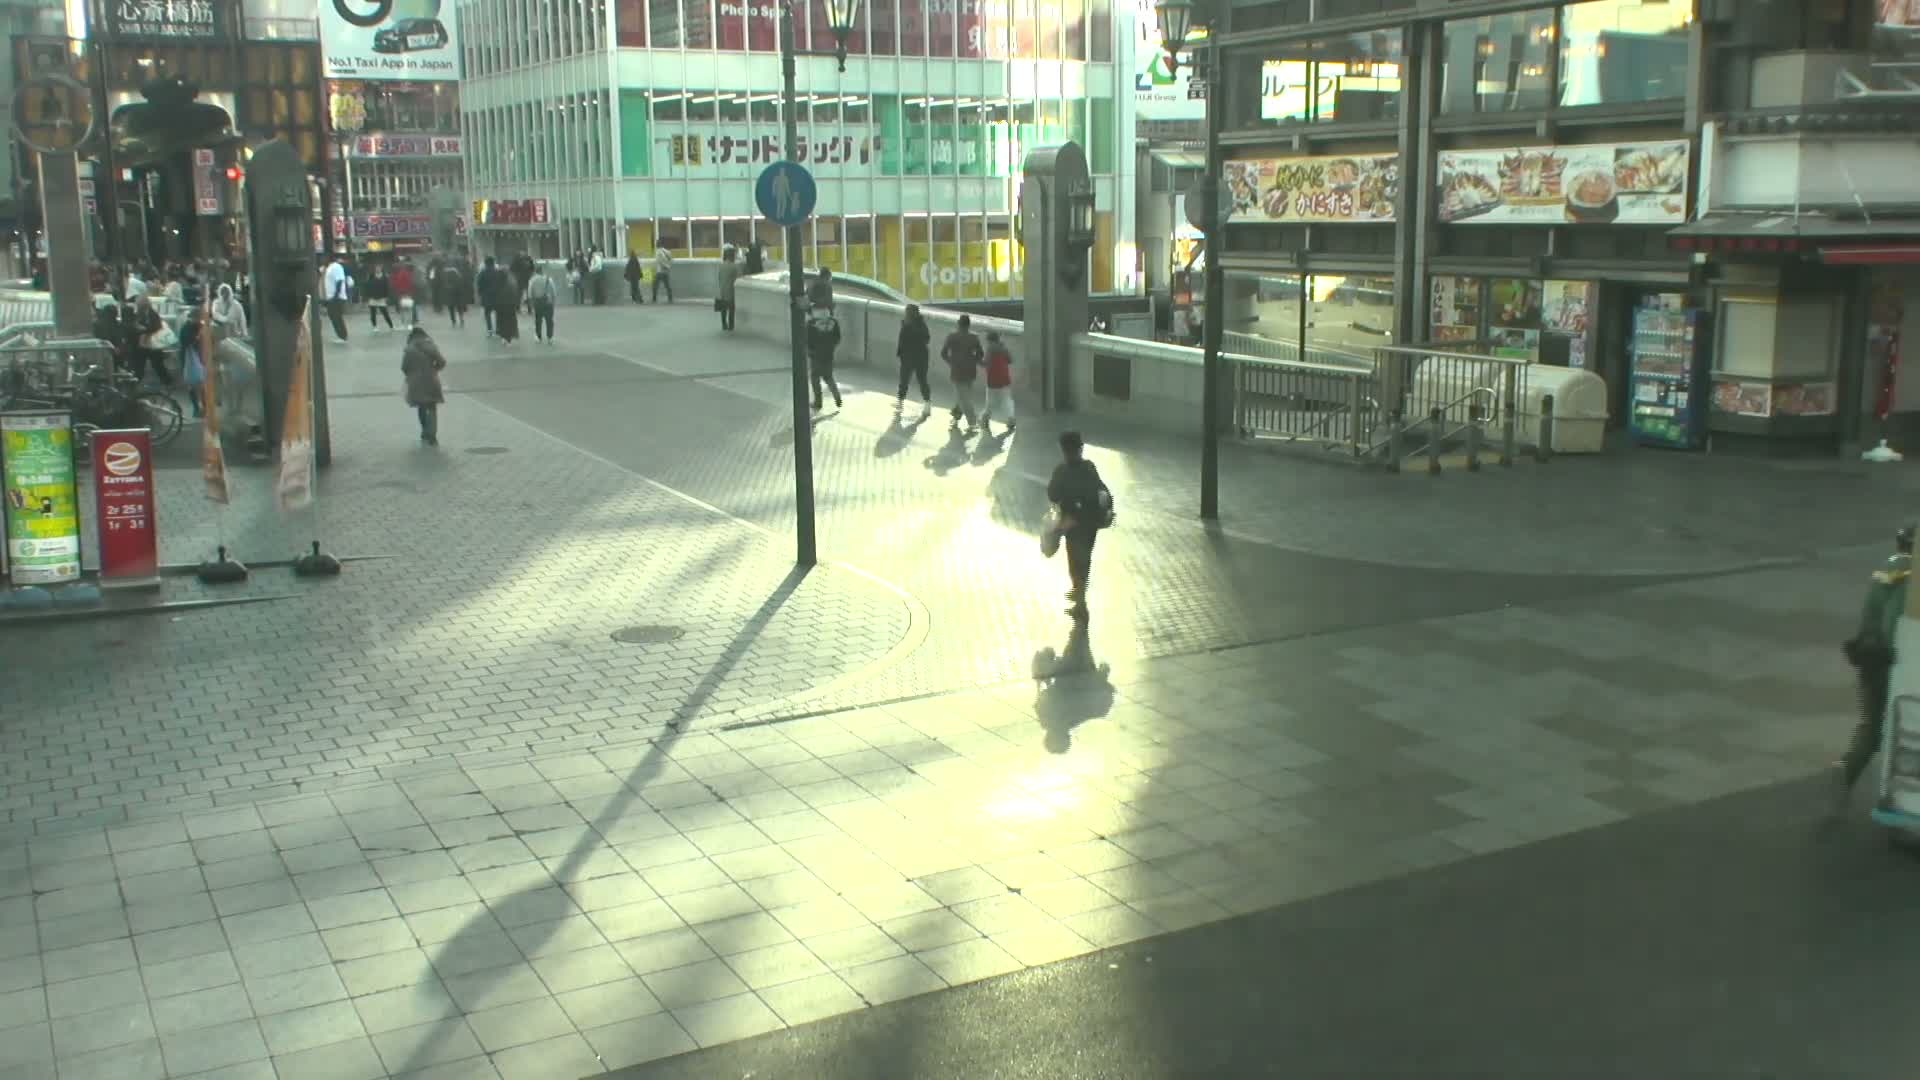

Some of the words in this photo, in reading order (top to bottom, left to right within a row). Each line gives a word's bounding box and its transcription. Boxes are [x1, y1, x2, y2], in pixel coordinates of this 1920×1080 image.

[720, 3, 758, 17] Photo
[355, 58, 378, 68] Taxi
[381, 59, 404, 71] App
[407, 60, 417, 69] in
[420, 60, 453, 72] Japan
[1295, 191, 1353, 216] かにすき
